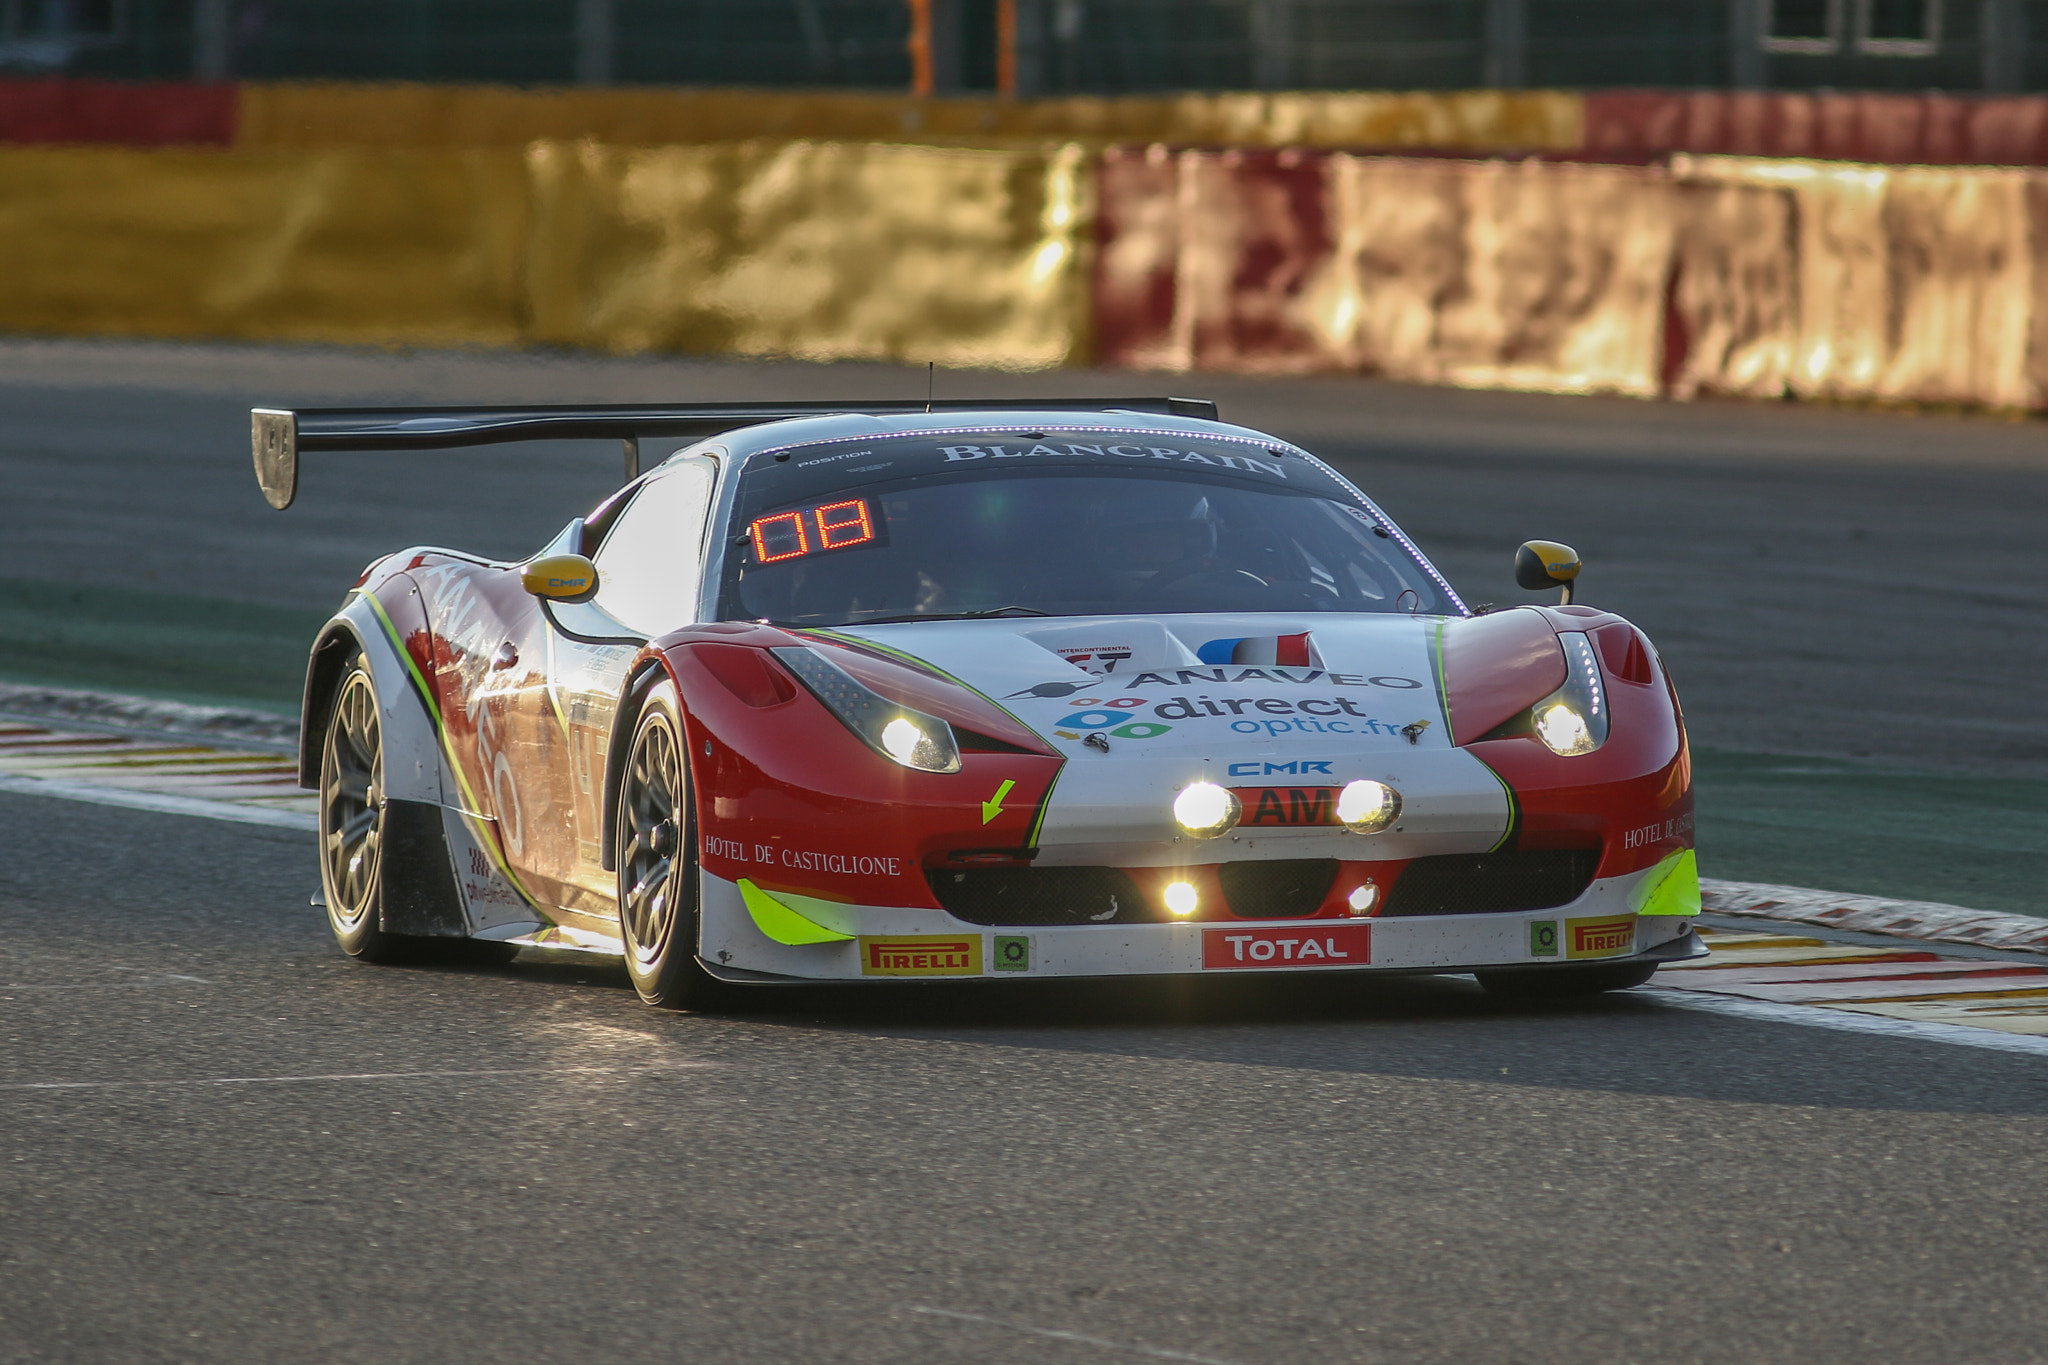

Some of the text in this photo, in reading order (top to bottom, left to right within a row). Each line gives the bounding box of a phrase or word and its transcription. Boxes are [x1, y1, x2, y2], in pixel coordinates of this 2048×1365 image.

[797, 450, 872, 468] POSITION
[938, 444, 1288, 479] BLANCPAIN
[548, 578, 587, 587] CMR
[1057, 646, 1131, 654] INTERCONTINENTAL
[1125, 668, 1423, 690] ANAVEO
[1153, 695, 1367, 720] direct
[1229, 715, 1402, 738] optic.fr
[1228, 761, 1334, 777] CMR
[1252, 789, 1335, 823] AM
[1624, 823, 1662, 849] HOTEL
[705, 835, 900, 876] HOTEL DE CASTIGLIONE
[1224, 935, 1348, 960] TOTAL
[1575, 921, 1635, 952] PIRELLI
[869, 942, 970, 969] PIRELLI
